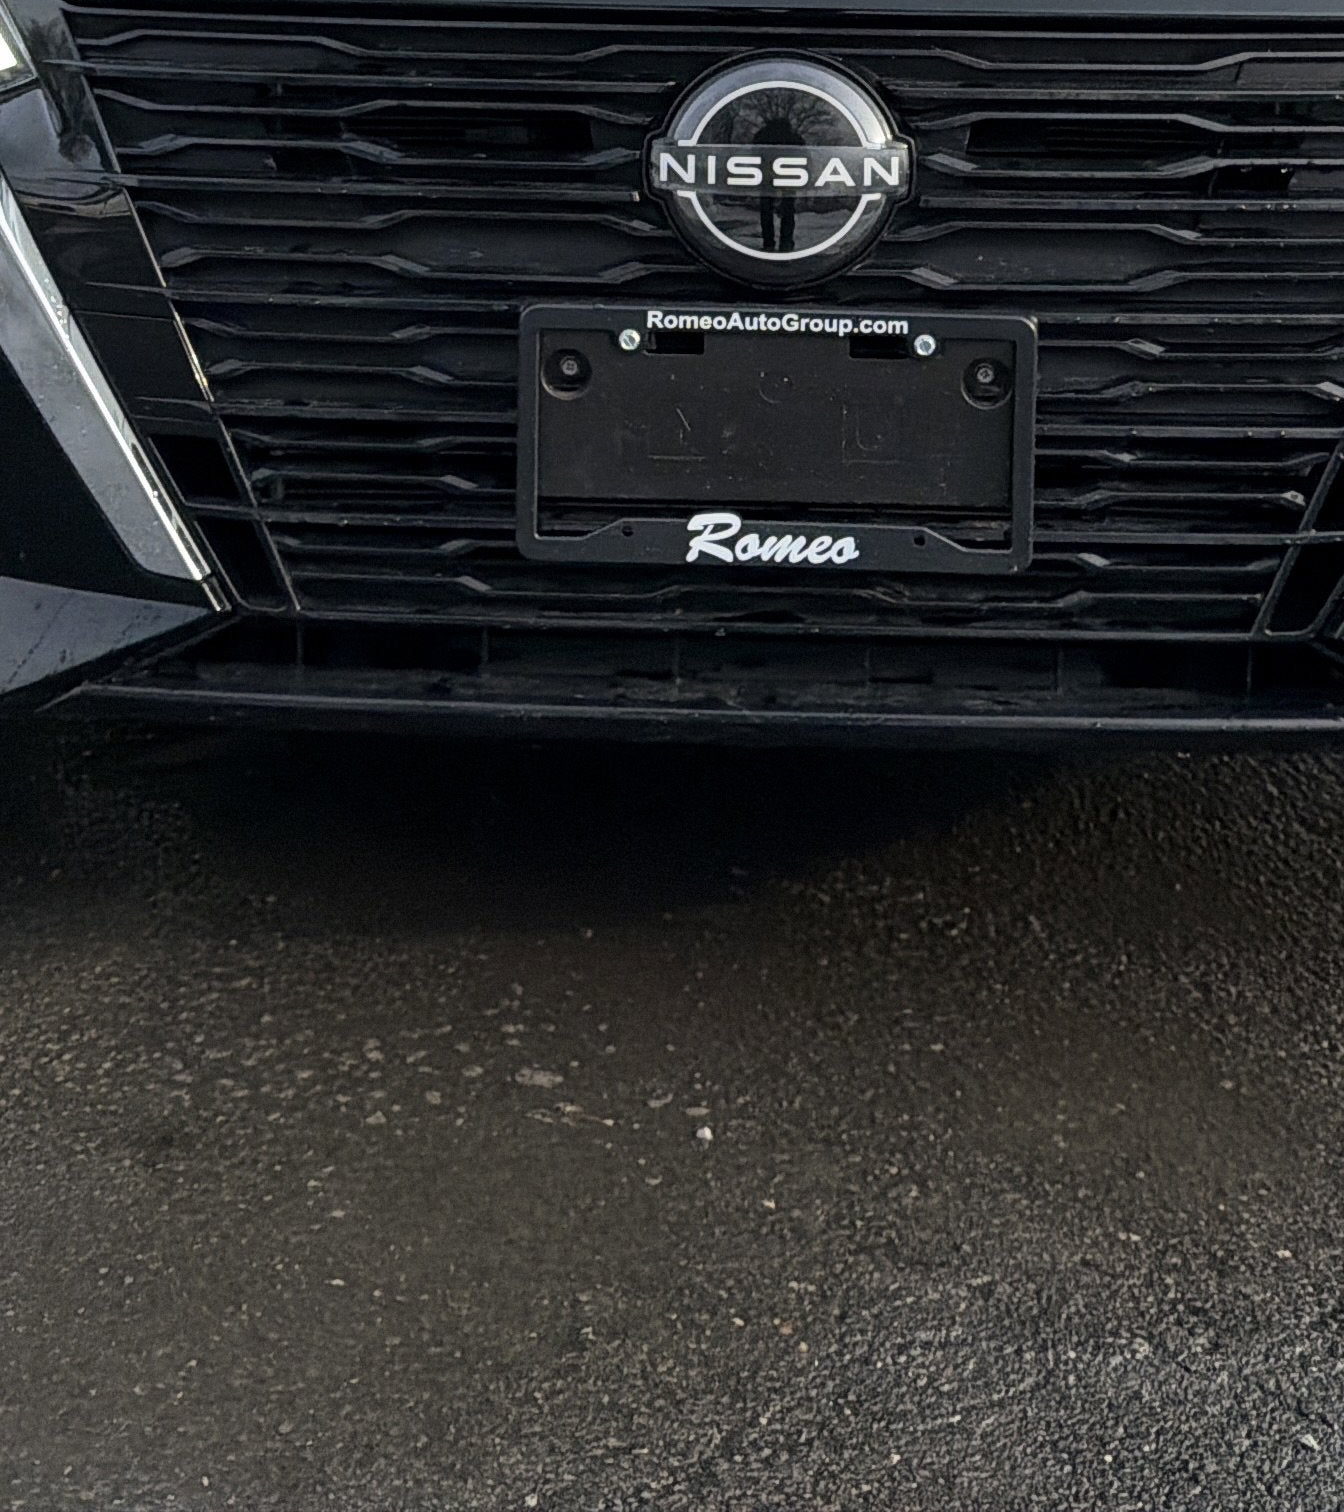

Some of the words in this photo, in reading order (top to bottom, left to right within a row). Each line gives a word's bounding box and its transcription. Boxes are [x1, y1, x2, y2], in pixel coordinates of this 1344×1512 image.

[658, 151, 900, 188] NISSAN
[646, 310, 910, 338] RomeoAutoGroup.com
[685, 511, 860, 566] Romeo
